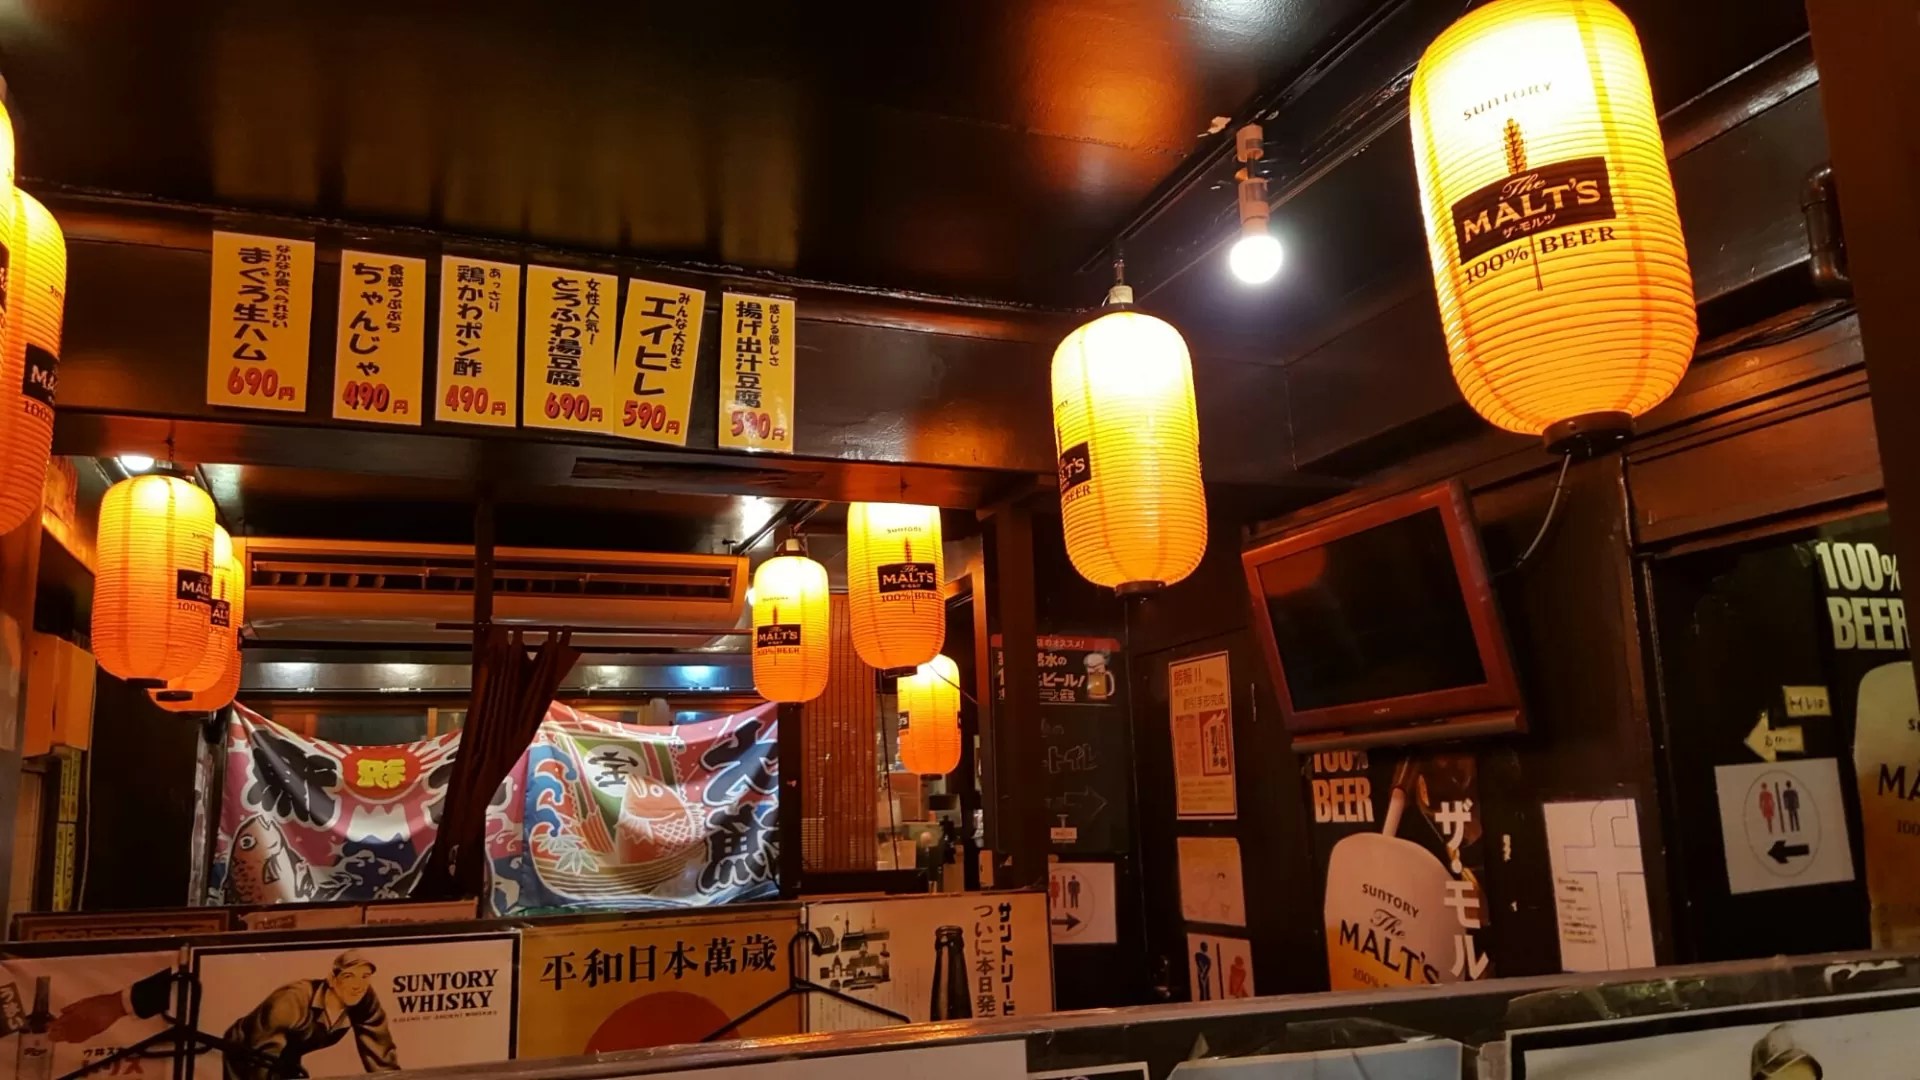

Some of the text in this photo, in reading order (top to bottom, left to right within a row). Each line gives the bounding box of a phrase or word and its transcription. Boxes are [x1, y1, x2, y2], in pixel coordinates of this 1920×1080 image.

[1463, 178, 1601, 244] MALT'S
[1500, 173, 1546, 199] The
[1464, 226, 1617, 285] 100% BEER
[232, 247, 273, 361] まぐろ生ハム
[272, 244, 292, 329] なかなか食べられない
[488, 267, 502, 313] あっさり
[349, 262, 385, 377] ちゃんじゃ
[453, 264, 486, 378] 鶏かわポン酢
[546, 276, 582, 387] とろふわ湯豆腐
[669, 293, 691, 369] みんな大好き
[769, 304, 781, 367] 感じる優しさ
[633, 296, 678, 396] エイヒレ
[735, 300, 763, 409] 揚げ出汁豆腐
[227, 367, 296, 401] 690円
[342, 381, 409, 415] 490円
[445, 384, 507, 416] 490円
[544, 392, 603, 422] 690円
[622, 400, 680, 435] 590円
[882, 570, 934, 586] MALT'S
[1816, 541, 1902, 592] 100%
[758, 630, 799, 643] MALT'S
[1827, 597, 1911, 650] BEER
[1312, 777, 1375, 823] BEER
[1371, 908, 1406, 938] The
[973, 903, 996, 1018] ついに本日発
[1339, 919, 1440, 986] MALT'S
[392, 969, 499, 993] SUNTORY
[398, 990, 493, 1014] WHISKY
